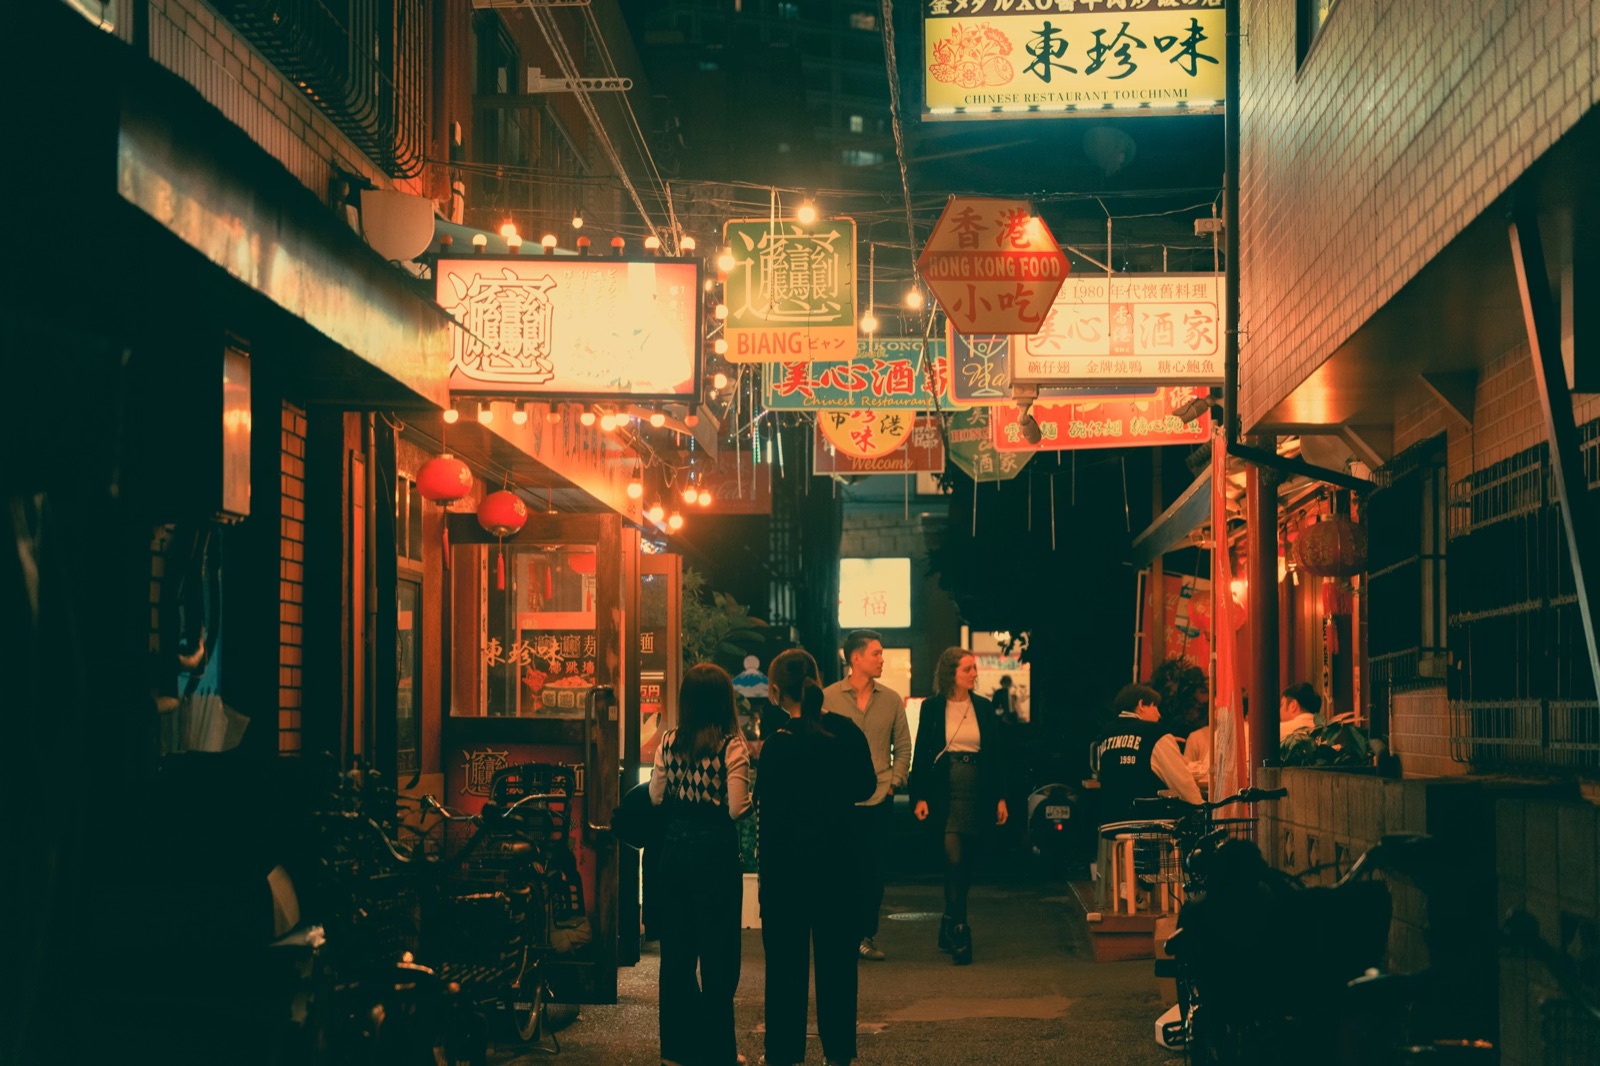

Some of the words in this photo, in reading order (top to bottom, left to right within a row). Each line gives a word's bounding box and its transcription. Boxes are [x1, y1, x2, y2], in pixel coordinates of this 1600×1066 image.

[1023, 18, 1219, 84] 東珍味
[965, 94, 1019, 104] CHINESE
[1025, 91, 1109, 103] RESTAURANT
[1113, 88, 1189, 100] TOUCHINMI
[950, 207, 1031, 249] 香港
[929, 256, 969, 277] HONG
[974, 256, 1015, 277] KONG
[1019, 256, 1061, 277] FOOD
[952, 283, 1040, 323] 小吃
[1073, 286, 1104, 299] 1980
[1140, 310, 1213, 350] 酒家
[737, 332, 802, 355] BIANG
[808, 337, 845, 350] ビャン
[962, 363, 1009, 387] Ba
[1028, 360, 1070, 374] 碗仔翅
[804, 396, 855, 407] Chinese
[861, 396, 935, 407] Restaurant
[851, 457, 914, 471] Welcome
[485, 637, 565, 668] 東珍味
